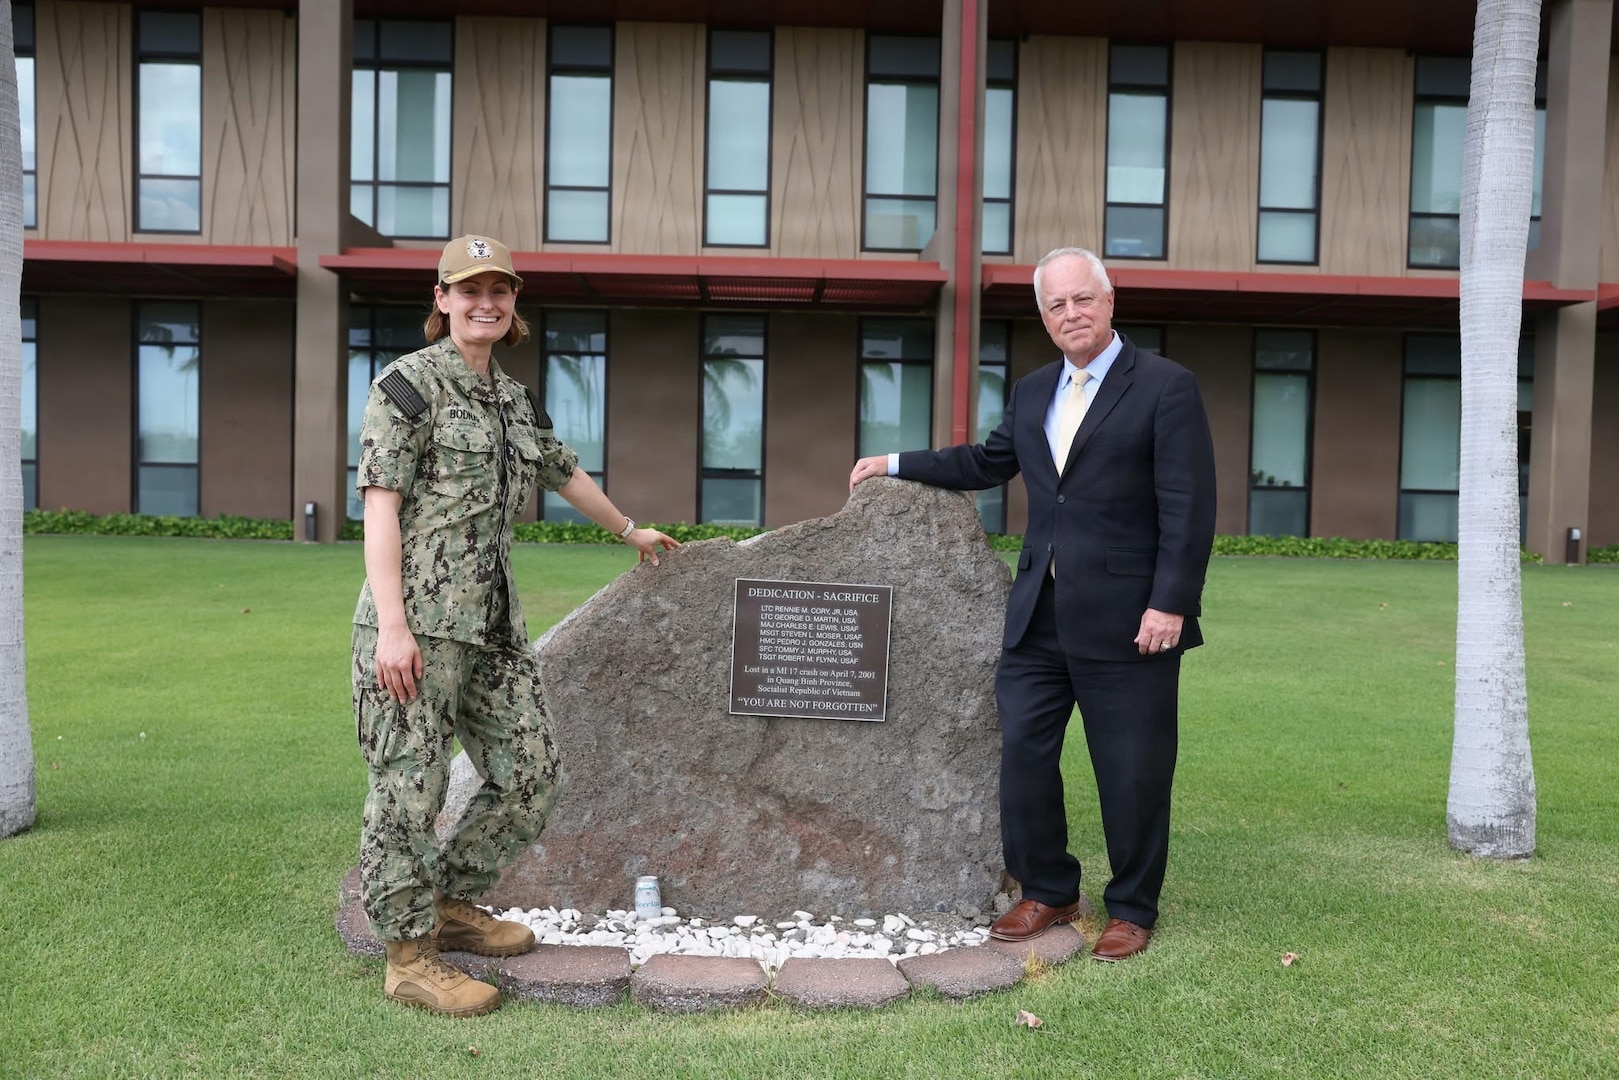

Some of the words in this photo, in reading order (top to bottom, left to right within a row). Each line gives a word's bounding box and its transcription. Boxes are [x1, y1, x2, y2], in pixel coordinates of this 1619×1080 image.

[748, 588, 814, 599] DEDICATION
[824, 592, 879, 602] SACRIFICE
[809, 640, 847, 648] GONZALES,
[830, 670, 849, 679] April
[776, 677, 799, 686] Quang
[819, 679, 852, 687] Province,
[790, 686, 820, 696] Republic
[832, 688, 860, 697] Vietnam
[766, 699, 787, 708] ARE
[789, 700, 811, 709] NOT
